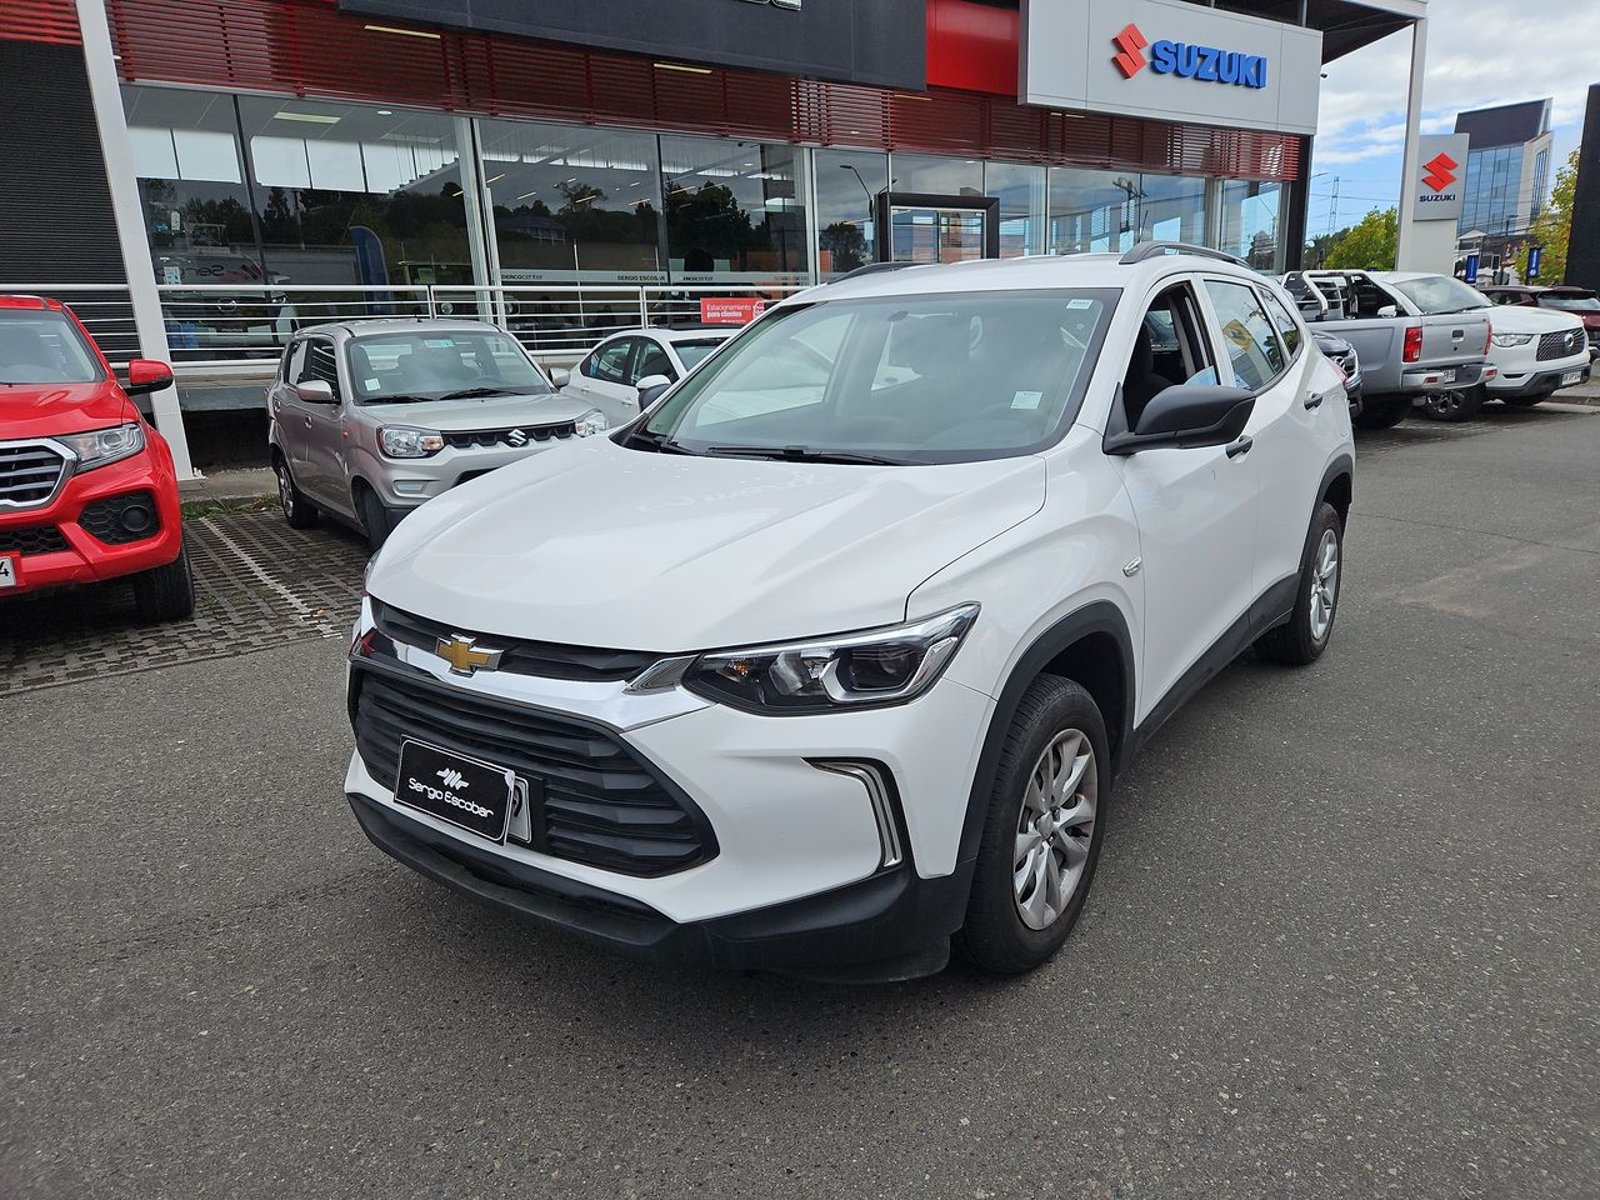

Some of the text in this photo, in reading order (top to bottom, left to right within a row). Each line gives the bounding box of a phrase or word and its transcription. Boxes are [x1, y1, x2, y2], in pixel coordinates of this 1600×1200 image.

[1150, 39, 1267, 89] SUZUKI
[1419, 194, 1456, 202] SUZUKI
[707, 311, 721, 319] para
[444, 790, 495, 818] Escobar
